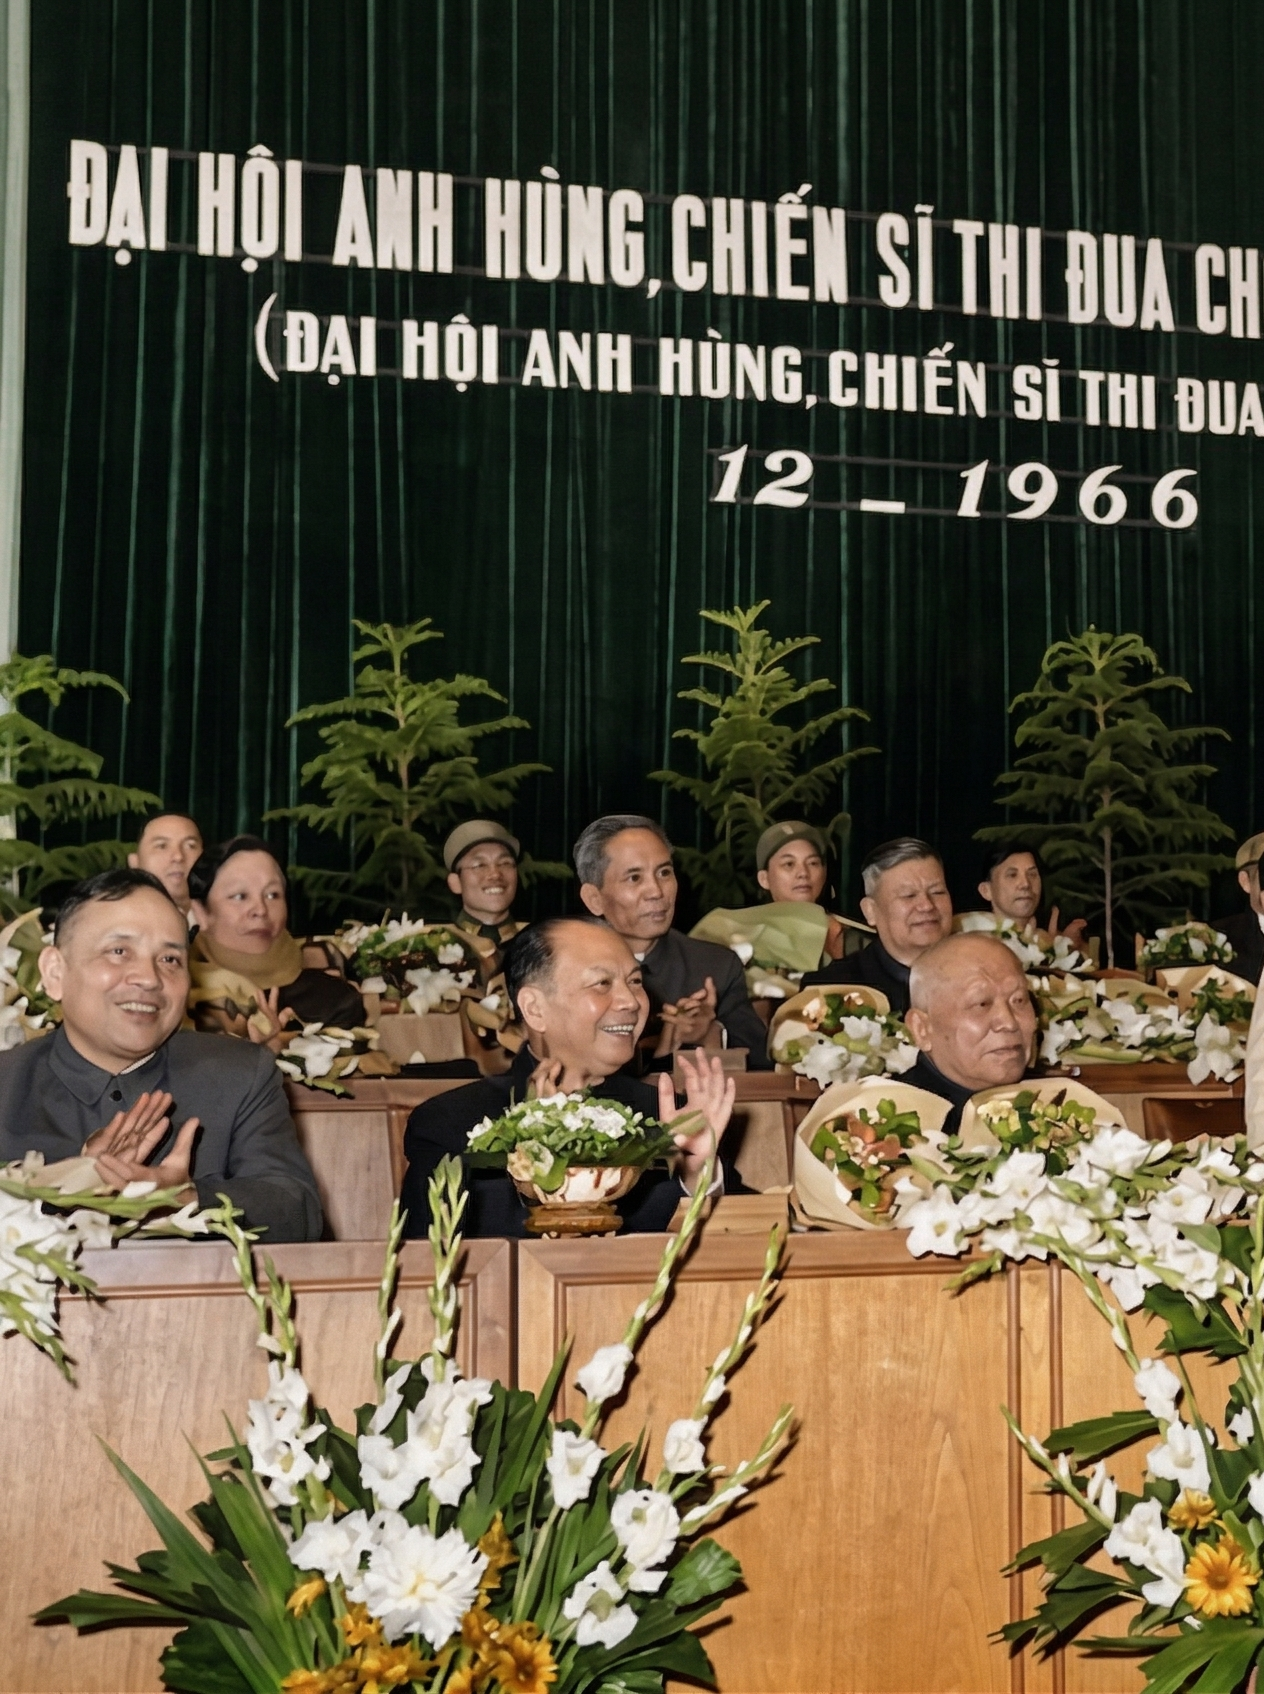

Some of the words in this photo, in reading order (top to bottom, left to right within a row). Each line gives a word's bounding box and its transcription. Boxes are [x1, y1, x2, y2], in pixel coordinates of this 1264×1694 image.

[66, 139, 170, 266] ĐẠI
[196, 144, 304, 273] HỘI
[331, 164, 454, 275] ANH
[484, 165, 663, 299] HÙNG,
[670, 183, 849, 305] CHIẾN
[952, 219, 1043, 322] THI
[1063, 229, 1176, 333] ĐUA
[255, 292, 377, 386] (ĐẠI
[401, 313, 499, 393] HỘI
[521, 328, 633, 394] ANH
[658, 328, 819, 411] HÙNG,
[827, 341, 989, 420] CHIẾN
[1078, 369, 1157, 431] THI
[712, 443, 815, 509] 12
[956, 459, 1200, 530] 1966
